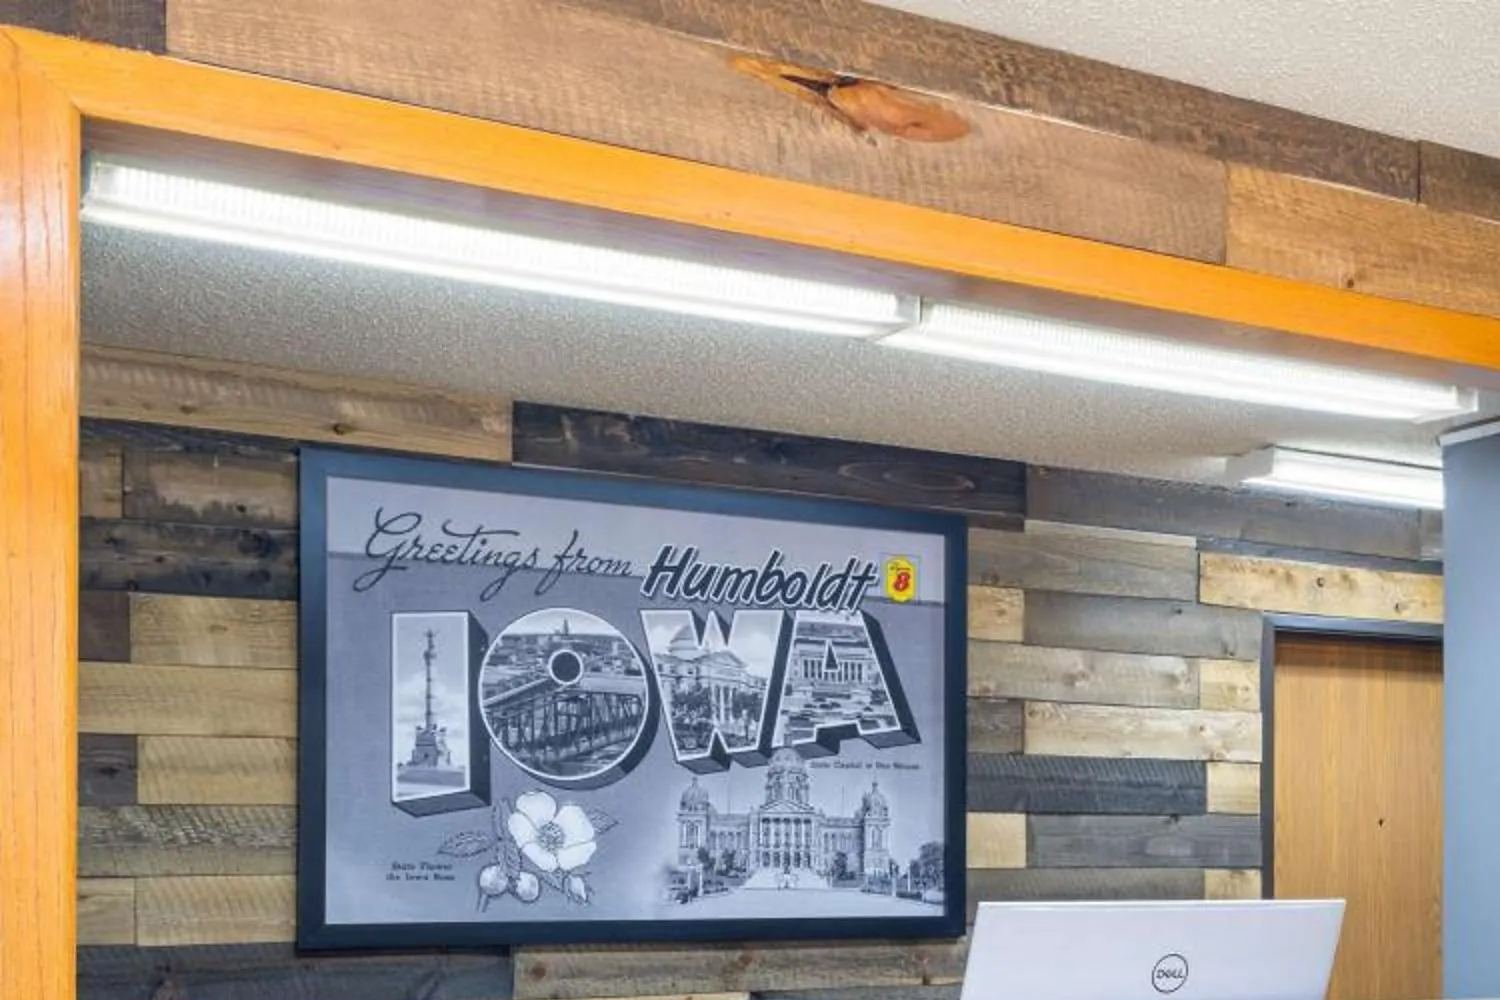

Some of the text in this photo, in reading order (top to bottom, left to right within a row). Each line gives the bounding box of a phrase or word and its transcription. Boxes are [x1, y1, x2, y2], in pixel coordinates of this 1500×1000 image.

[353, 506, 878, 611] Greetings from Humboldt
[390, 607, 920, 818] IOWA
